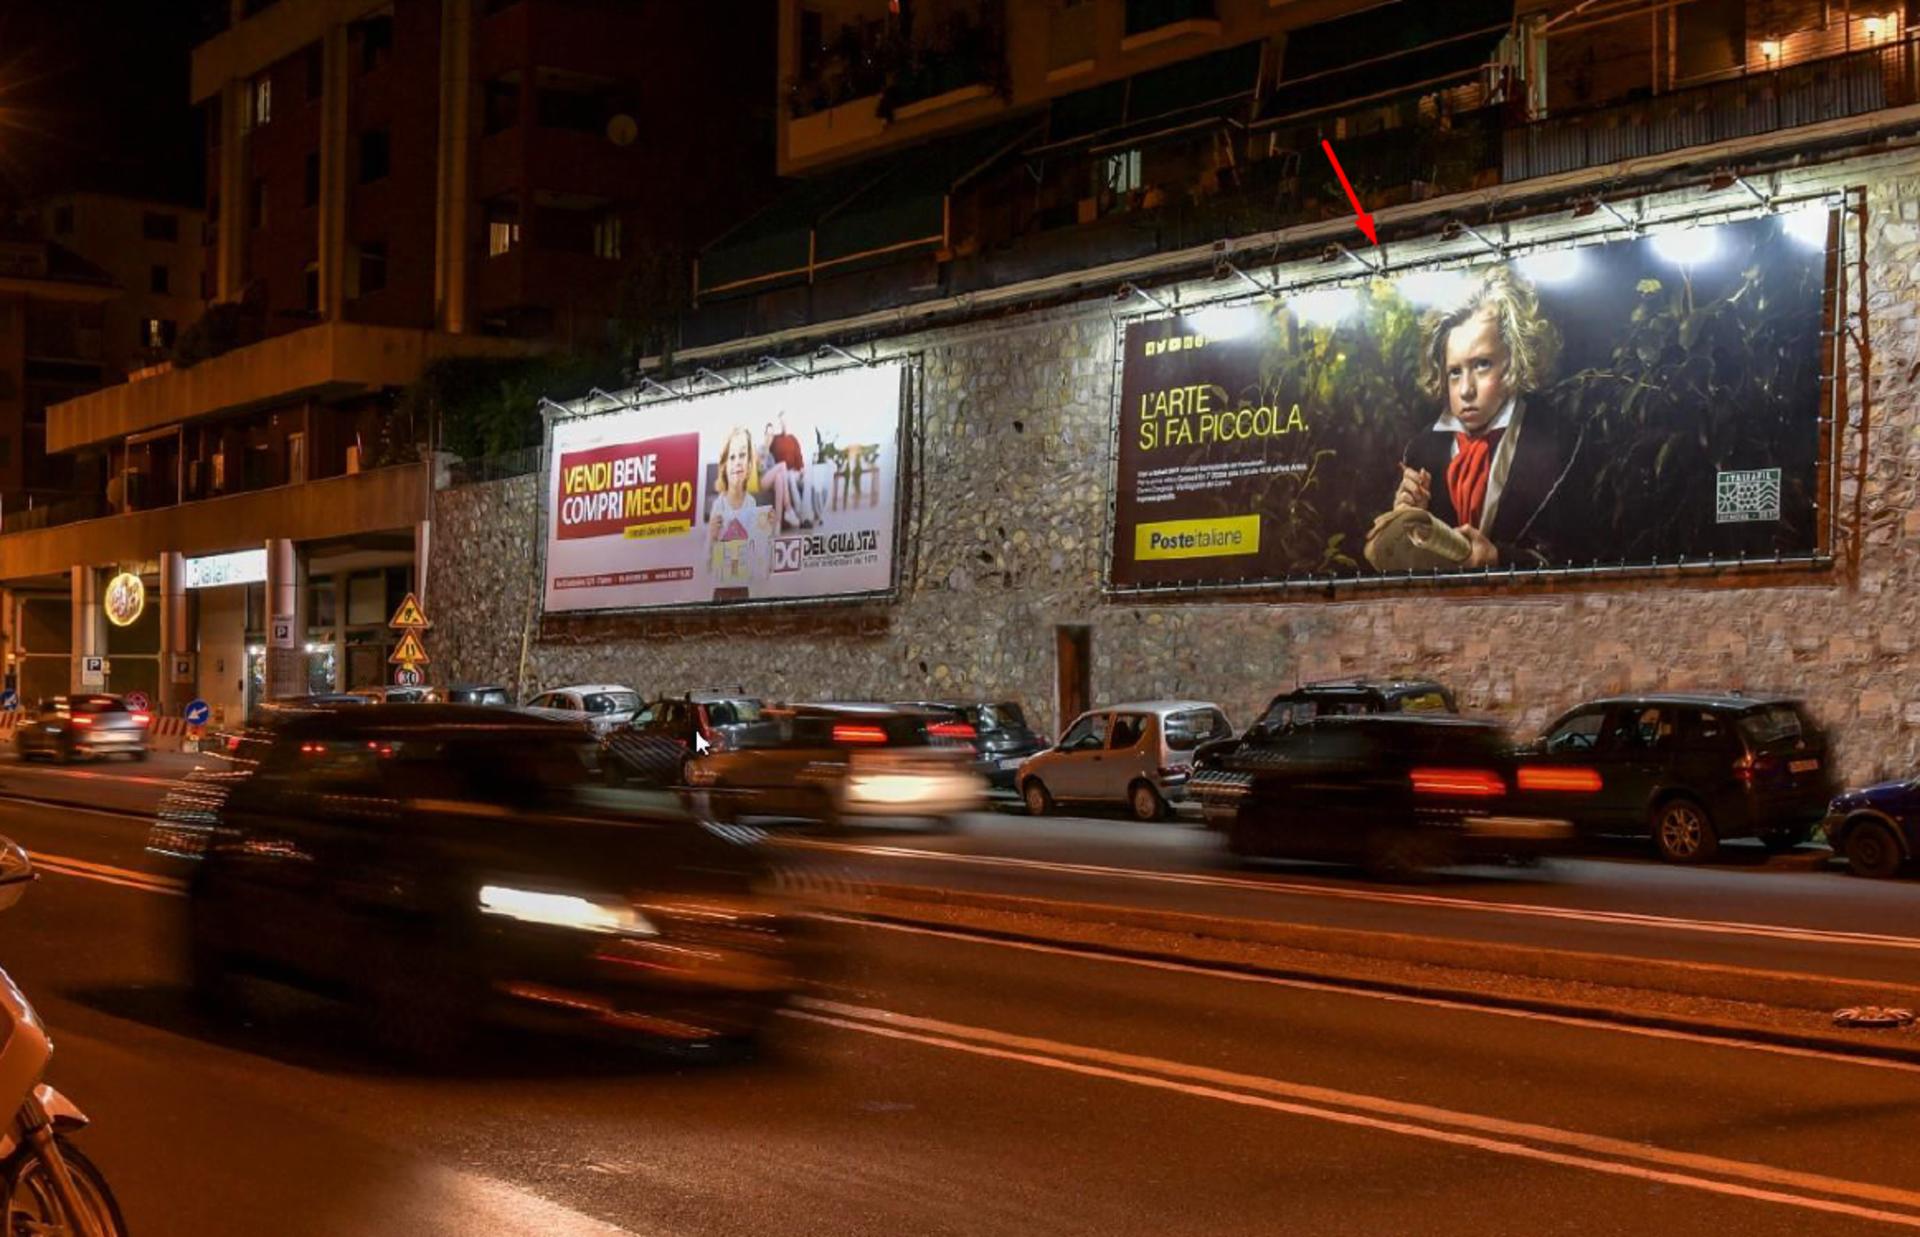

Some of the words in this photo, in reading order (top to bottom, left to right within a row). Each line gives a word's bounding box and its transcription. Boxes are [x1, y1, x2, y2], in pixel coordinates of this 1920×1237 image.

[1141, 385, 1212, 420] L'ARTE
[1139, 422, 1158, 450] SI
[1165, 418, 1193, 446] FA
[1199, 404, 1309, 443] PICCOLA.
[564, 462, 612, 494] VENDI
[613, 455, 656, 486] BENE
[562, 492, 623, 525] COMPRI
[625, 482, 692, 518] MEGLIO
[803, 536, 825, 556] DEL
[828, 530, 877, 553] GUASTA
